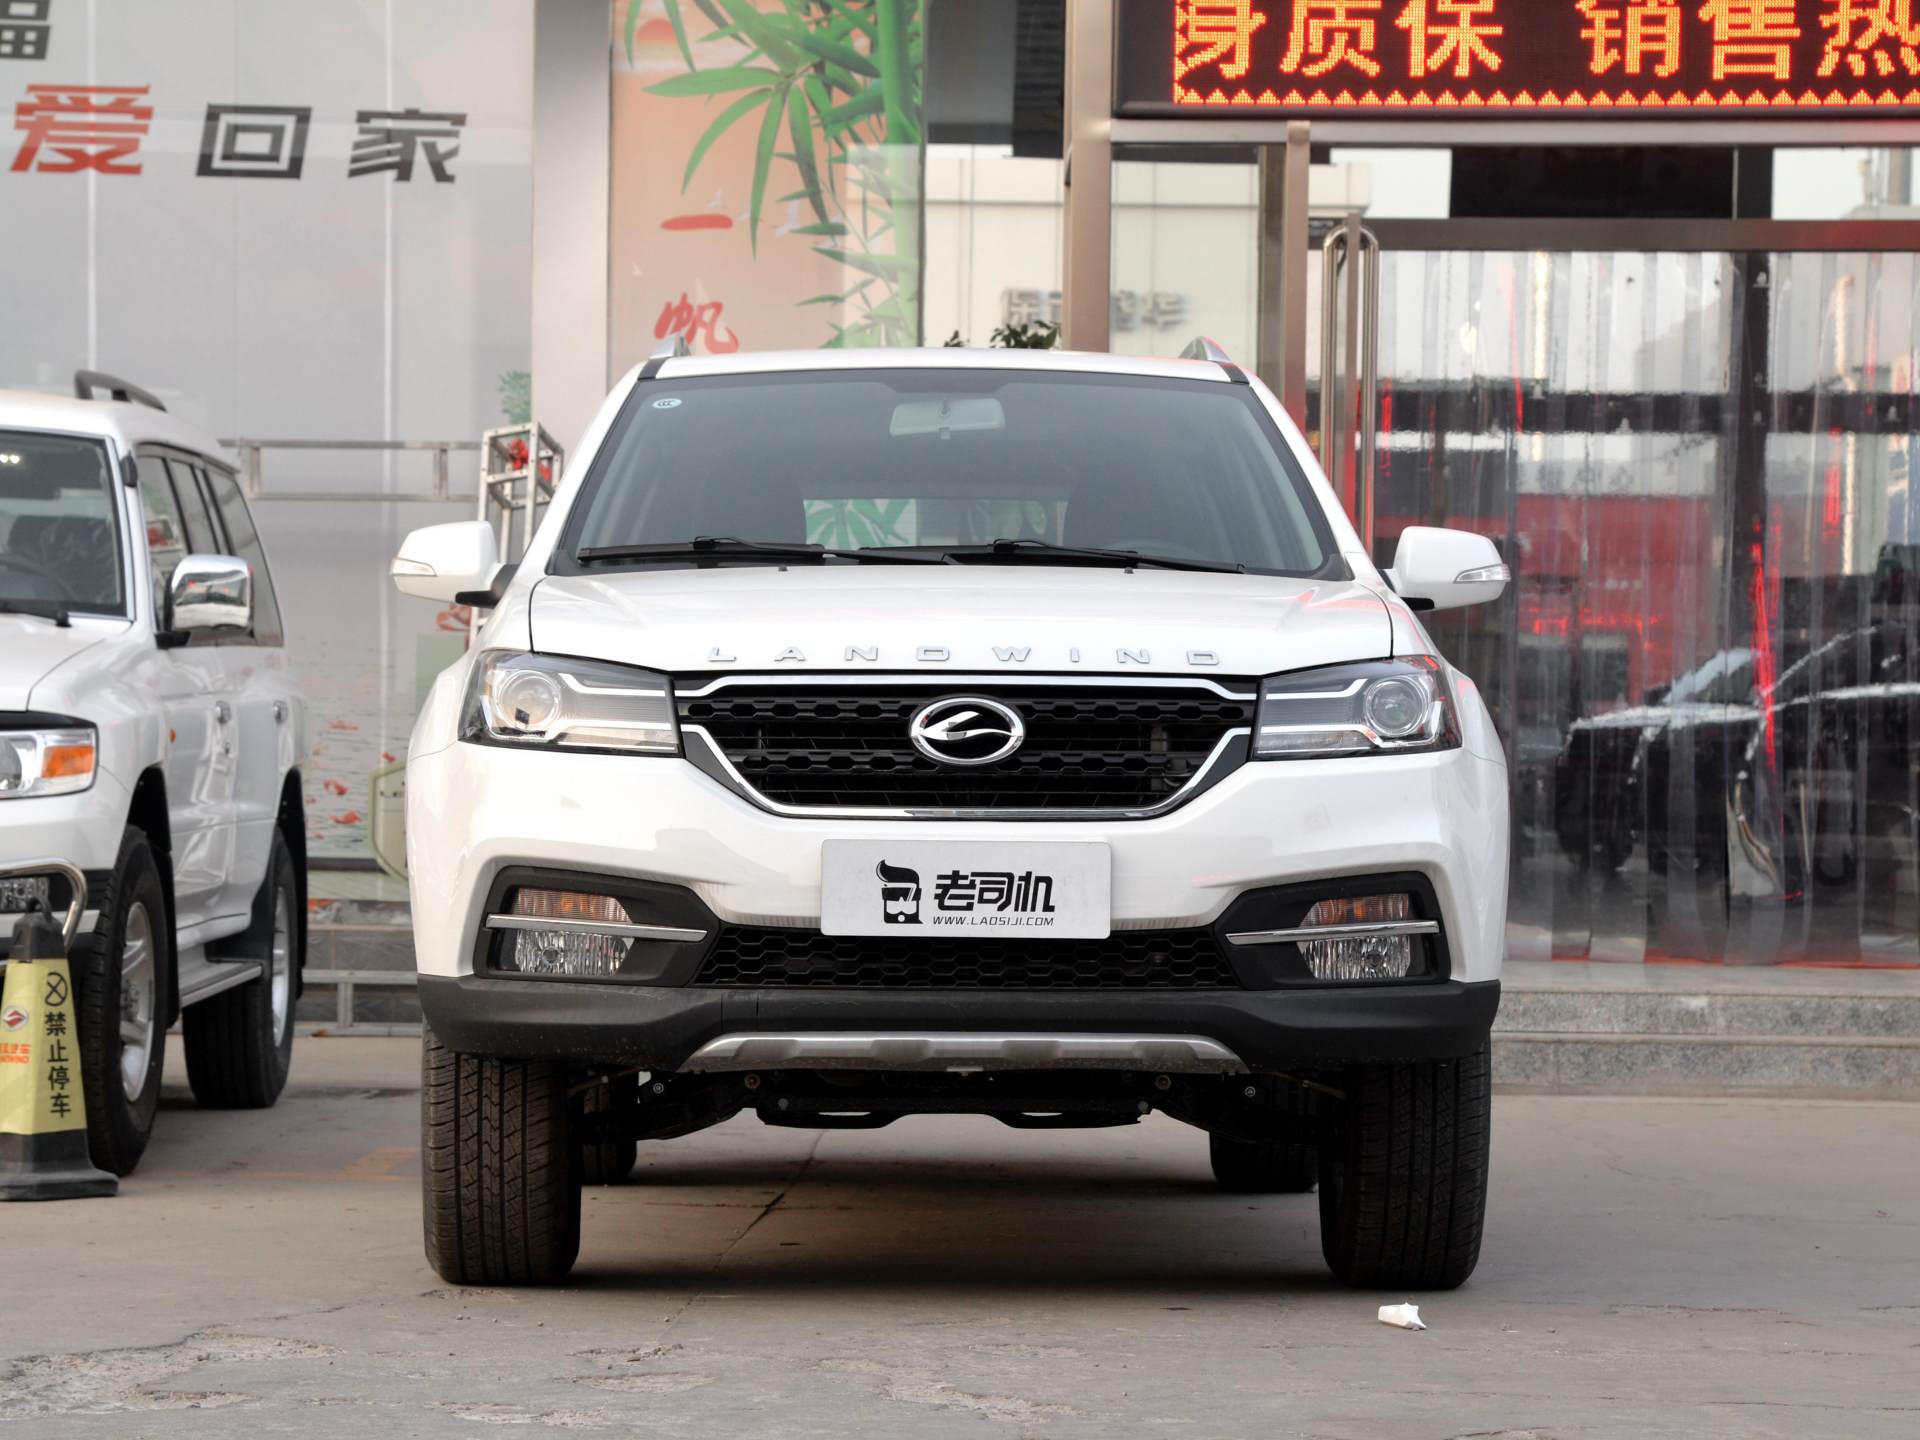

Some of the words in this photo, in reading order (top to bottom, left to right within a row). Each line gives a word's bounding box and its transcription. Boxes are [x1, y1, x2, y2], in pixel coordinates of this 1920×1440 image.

[707, 646, 1220, 666] LANDWIND
[933, 869, 1056, 913] 老司机
[932, 915, 1054, 927] WWW.LAOSIJI.COM
[44, 1011, 72, 1119] 禁止停车
